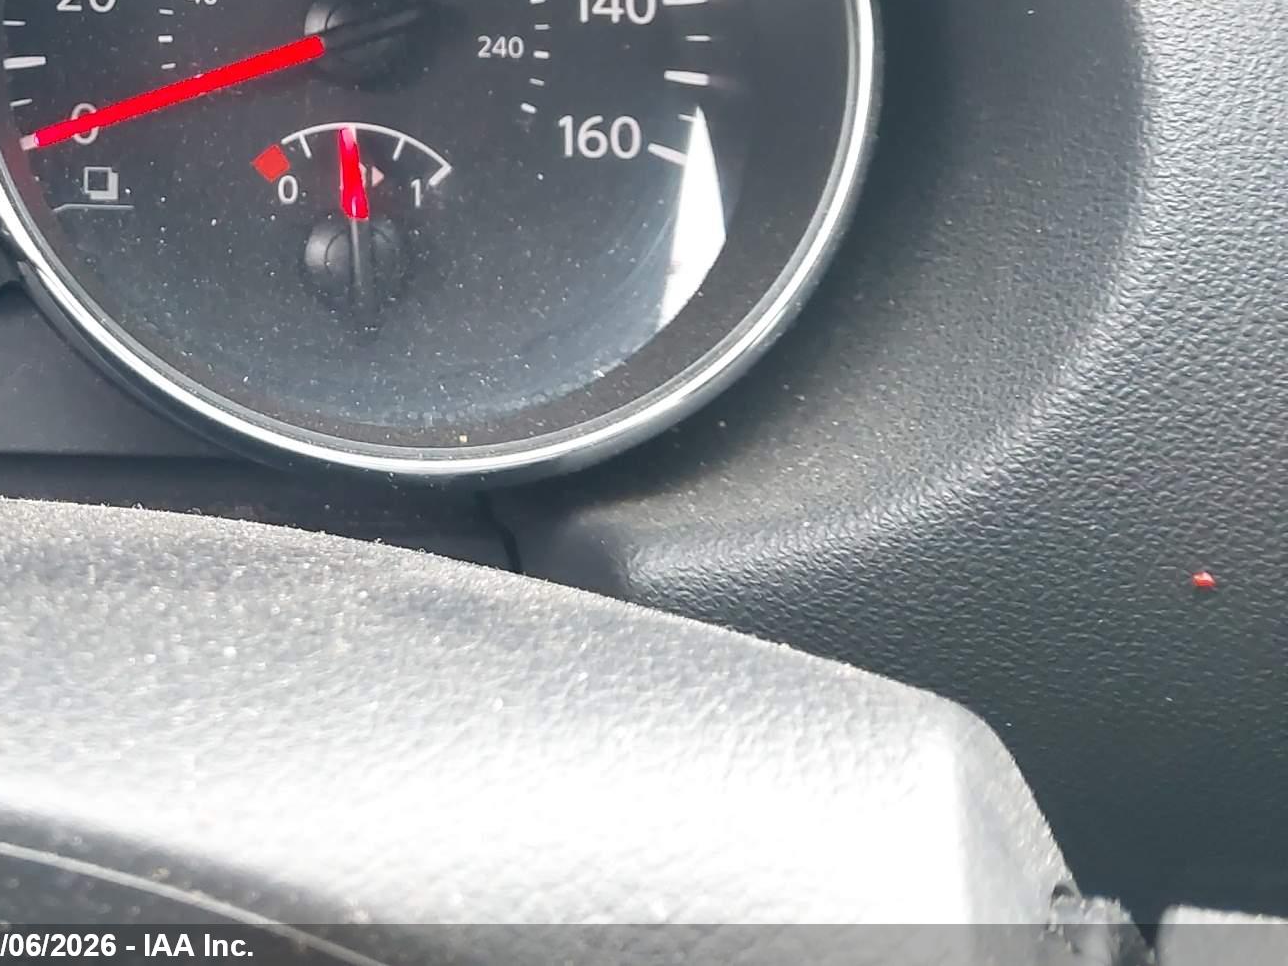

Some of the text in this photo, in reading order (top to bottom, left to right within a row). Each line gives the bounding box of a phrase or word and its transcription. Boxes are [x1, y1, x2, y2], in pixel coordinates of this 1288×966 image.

[478, 36, 524, 58] 240
[559, 115, 642, 159] 160
[277, 175, 299, 204] 0
[410, 178, 423, 207] 1
